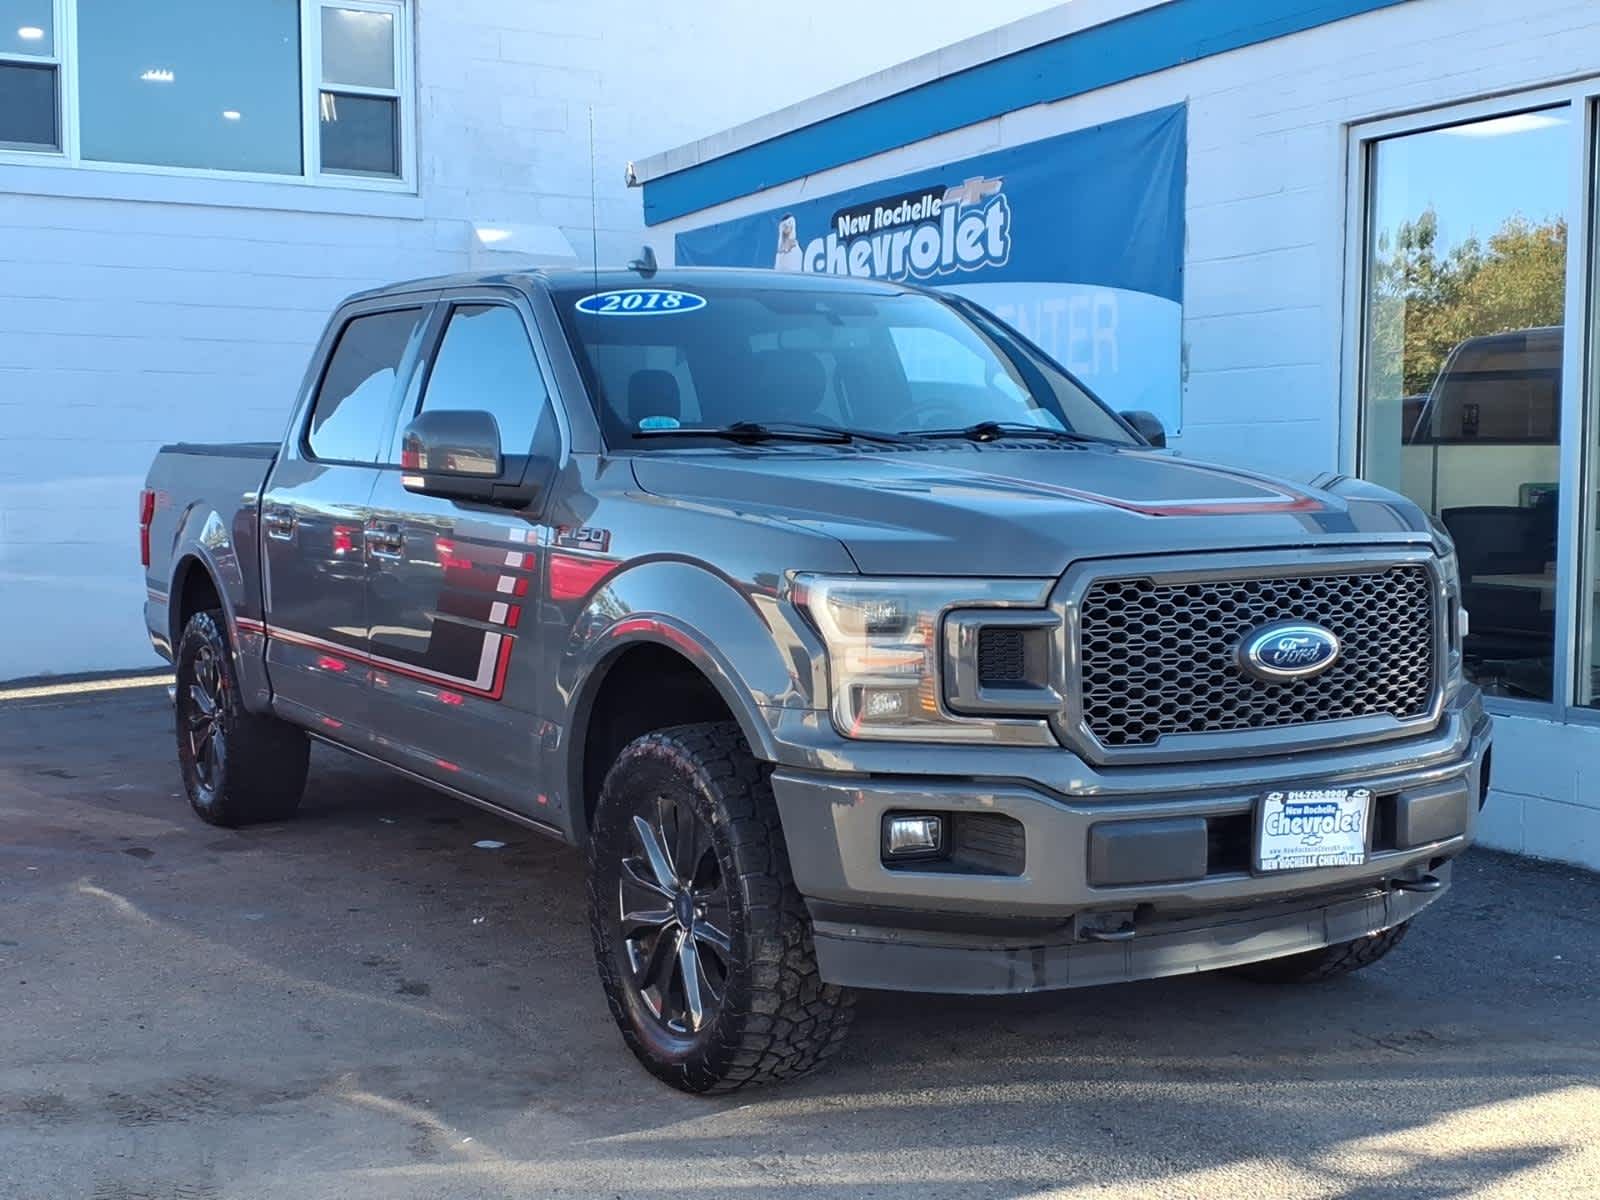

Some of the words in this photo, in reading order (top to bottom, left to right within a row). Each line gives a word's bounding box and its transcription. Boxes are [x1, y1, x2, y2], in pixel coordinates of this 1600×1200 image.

[838, 213, 871, 238] New
[874, 194, 942, 230] Rochelle
[803, 200, 1006, 279] Chevrolet
[600, 293, 683, 311] 2018
[1273, 637, 1321, 664] Ford
[1265, 808, 1361, 837] Chevrolet
[1285, 806, 1303, 815] New
[1303, 804, 1337, 814] Rochelle
[1318, 853, 1365, 866] CHEVROLET
